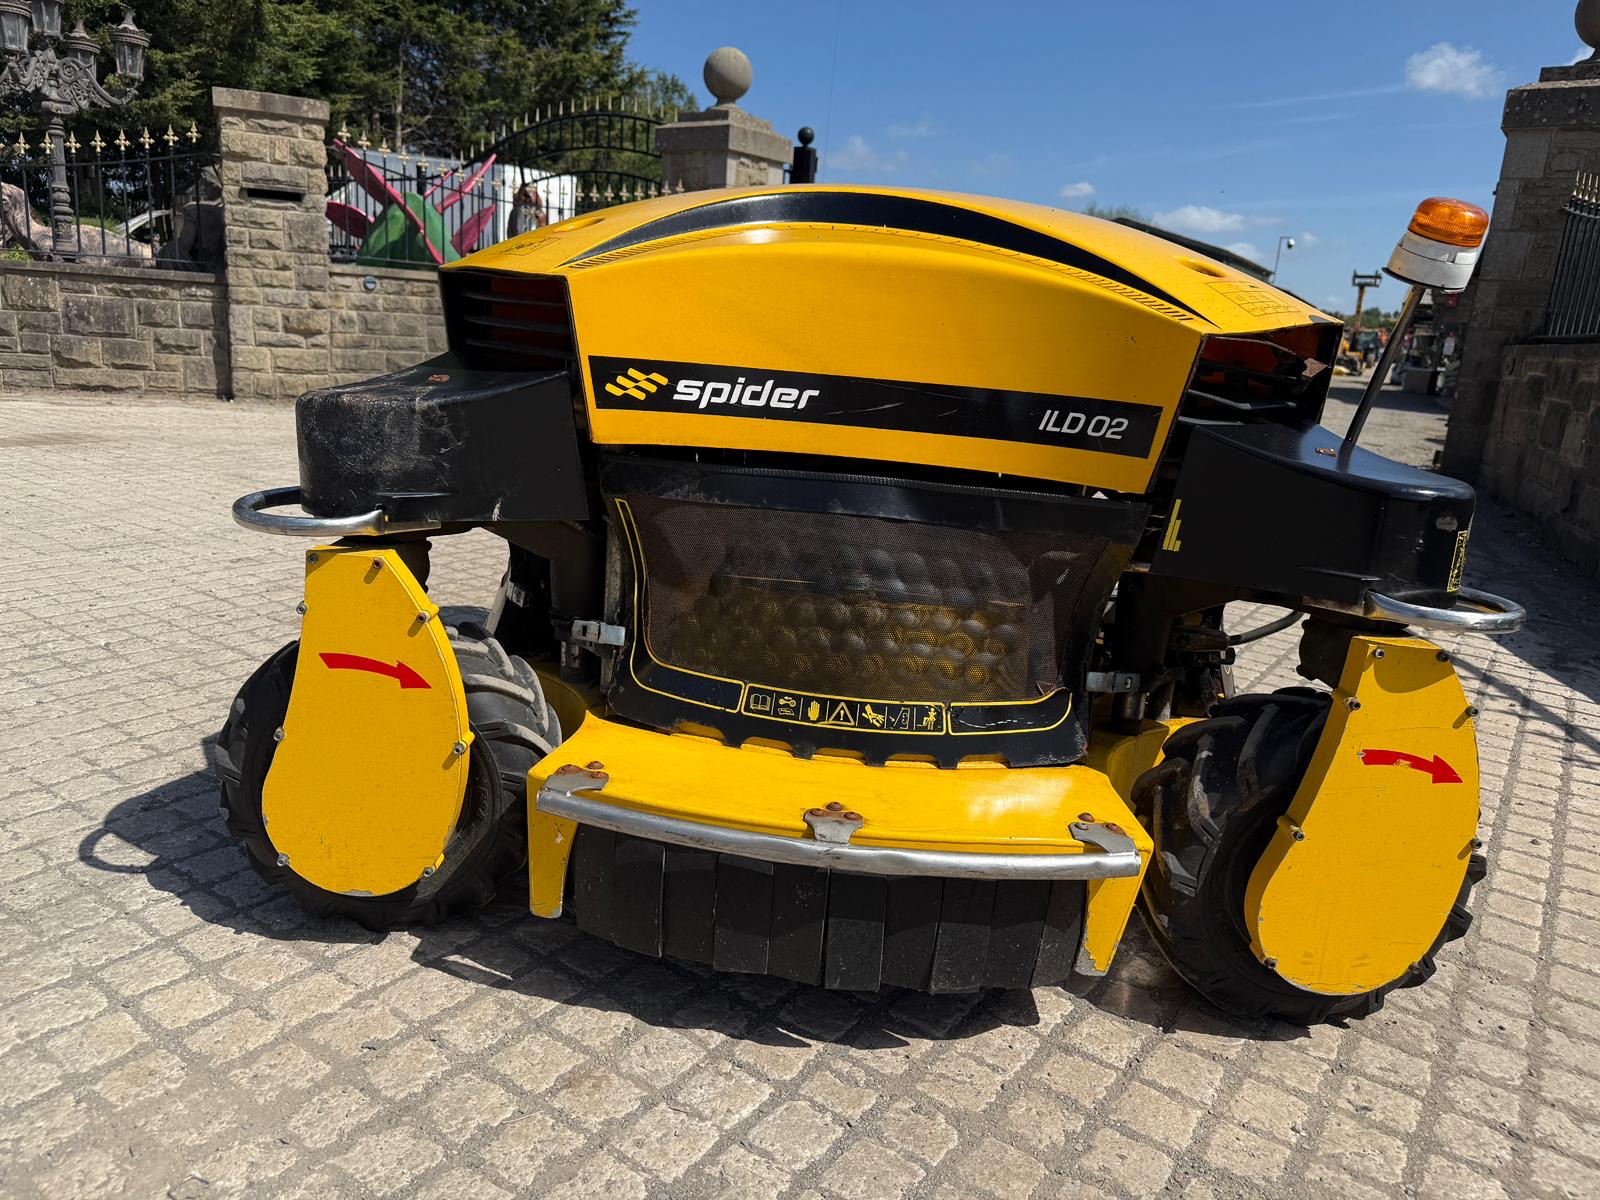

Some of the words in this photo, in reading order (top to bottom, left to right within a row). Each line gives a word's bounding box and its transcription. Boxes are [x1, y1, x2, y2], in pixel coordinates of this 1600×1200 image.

[673, 377, 820, 409] spider
[1038, 409, 1087, 434] ILD
[1086, 415, 1129, 440] 02
